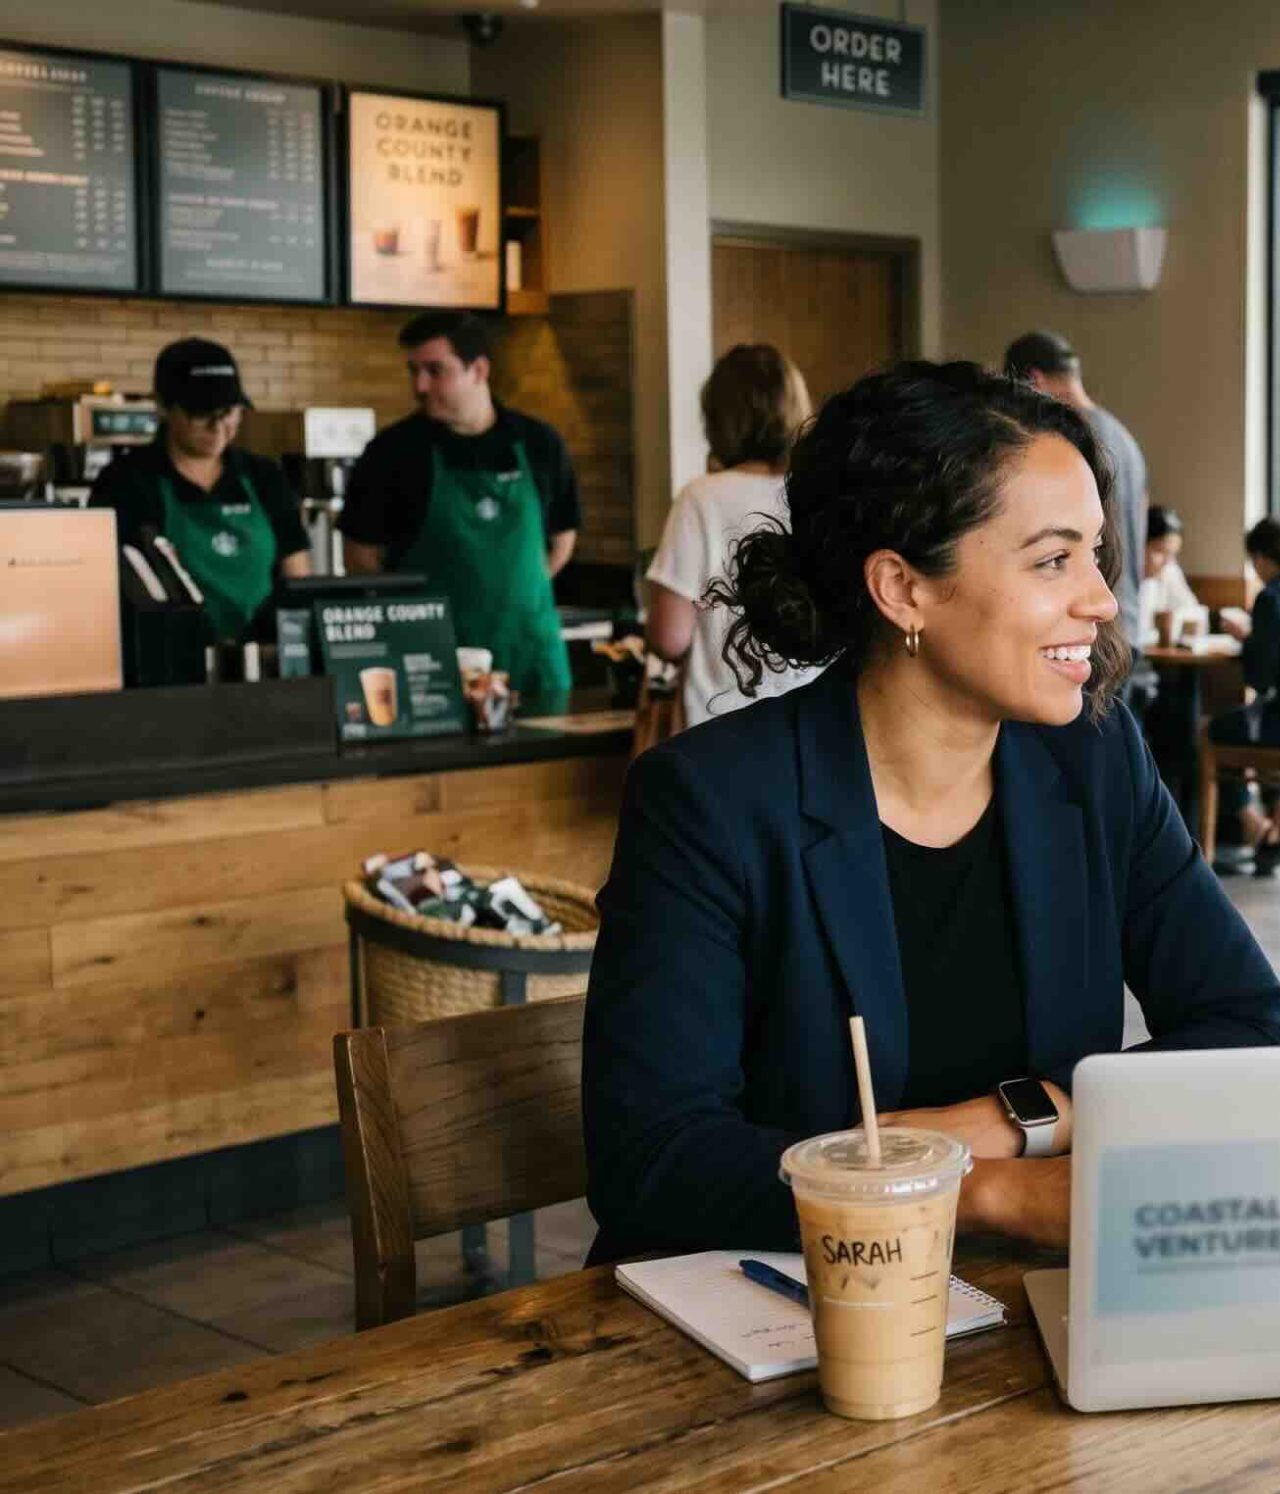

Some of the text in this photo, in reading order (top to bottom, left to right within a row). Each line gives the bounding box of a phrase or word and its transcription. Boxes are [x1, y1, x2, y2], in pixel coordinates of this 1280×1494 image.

[809, 24, 902, 64] ORDER
[821, 61, 890, 97] HERE
[375, 112, 472, 140] ORANGE
[376, 138, 472, 162] COUNTY
[387, 162, 463, 187] BLEND
[322, 603, 445, 624] ORANGE COUNTY
[325, 623, 376, 642] BLEND
[821, 1234, 903, 1267] SARAH
